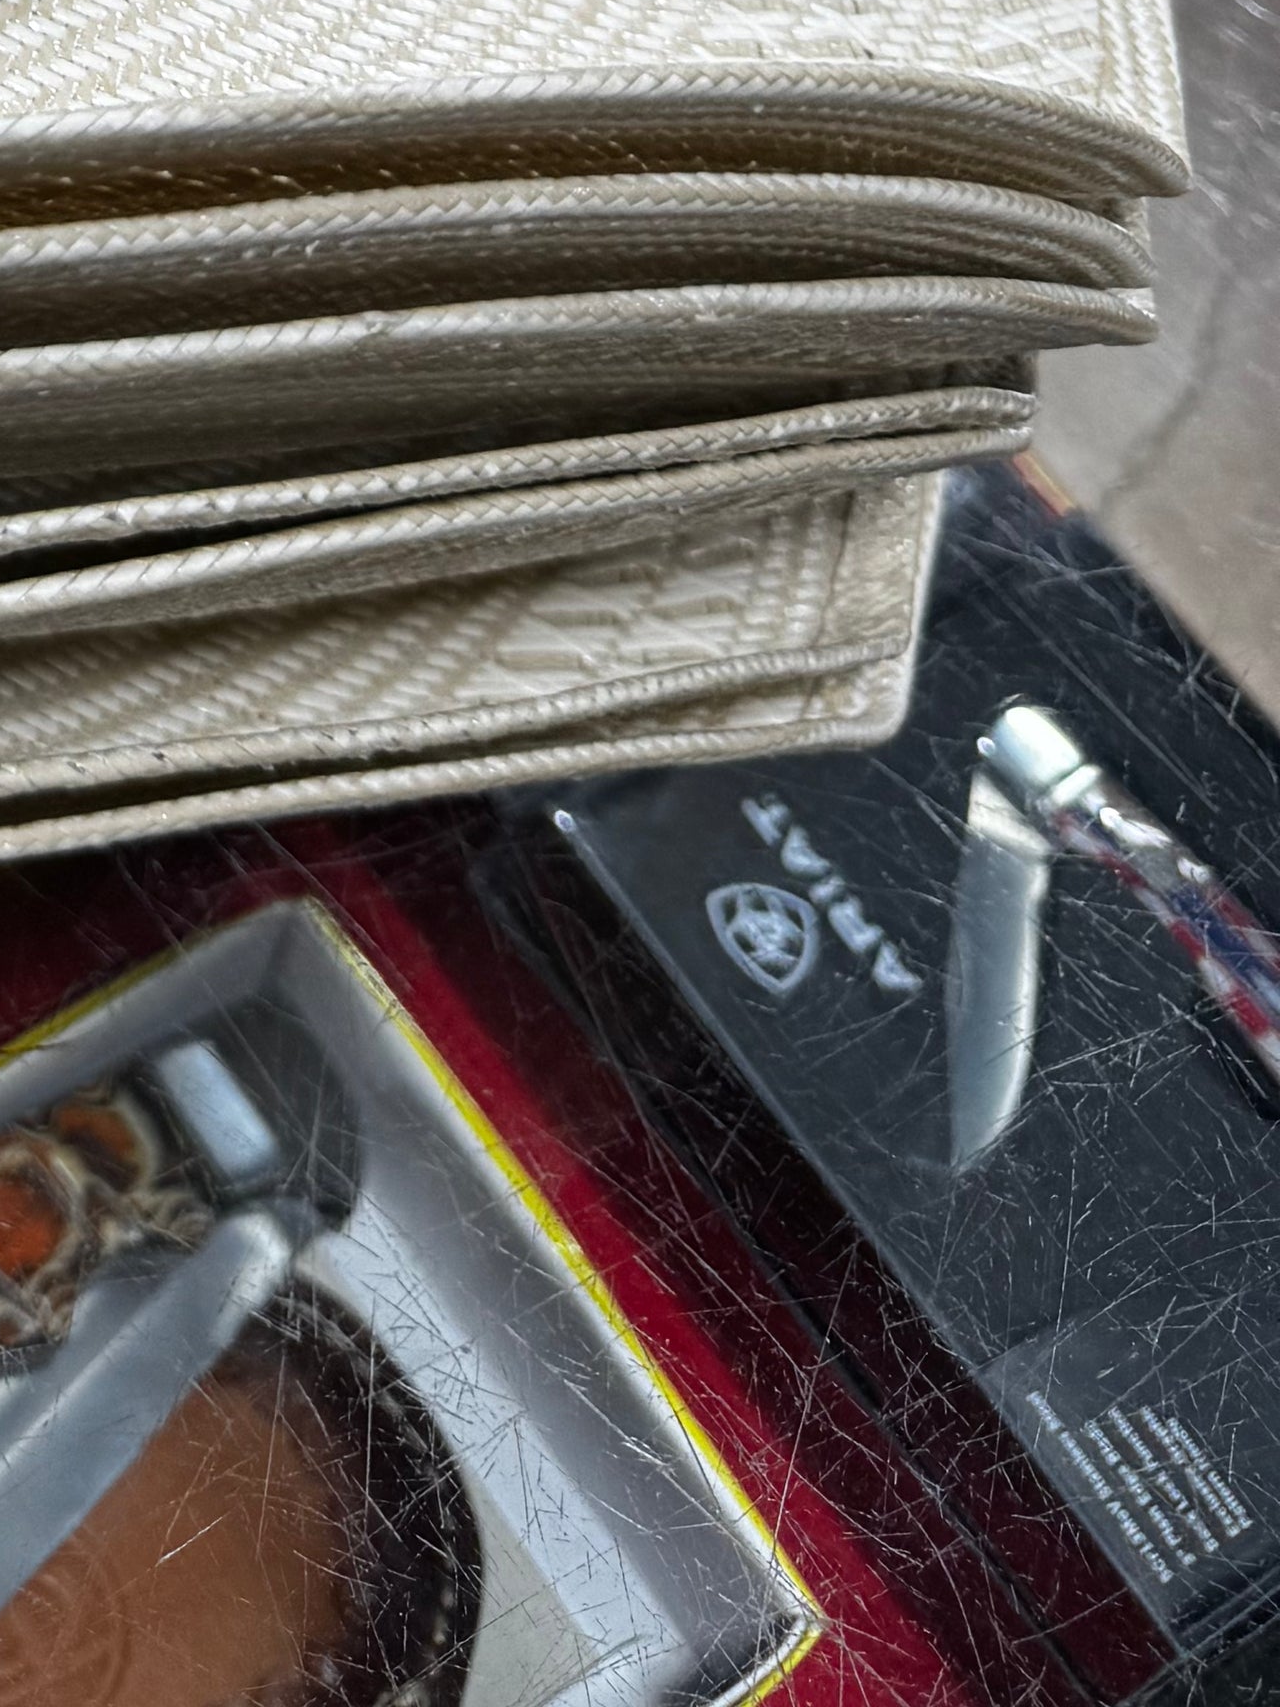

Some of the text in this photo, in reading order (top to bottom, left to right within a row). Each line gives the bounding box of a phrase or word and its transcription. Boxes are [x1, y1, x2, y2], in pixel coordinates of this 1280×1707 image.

[741, 793, 924, 991] ARIAT
[1108, 1406, 1159, 1471] Function
[1148, 1504, 1182, 1546] Plain
[1207, 1470, 1253, 1529] Pattern
